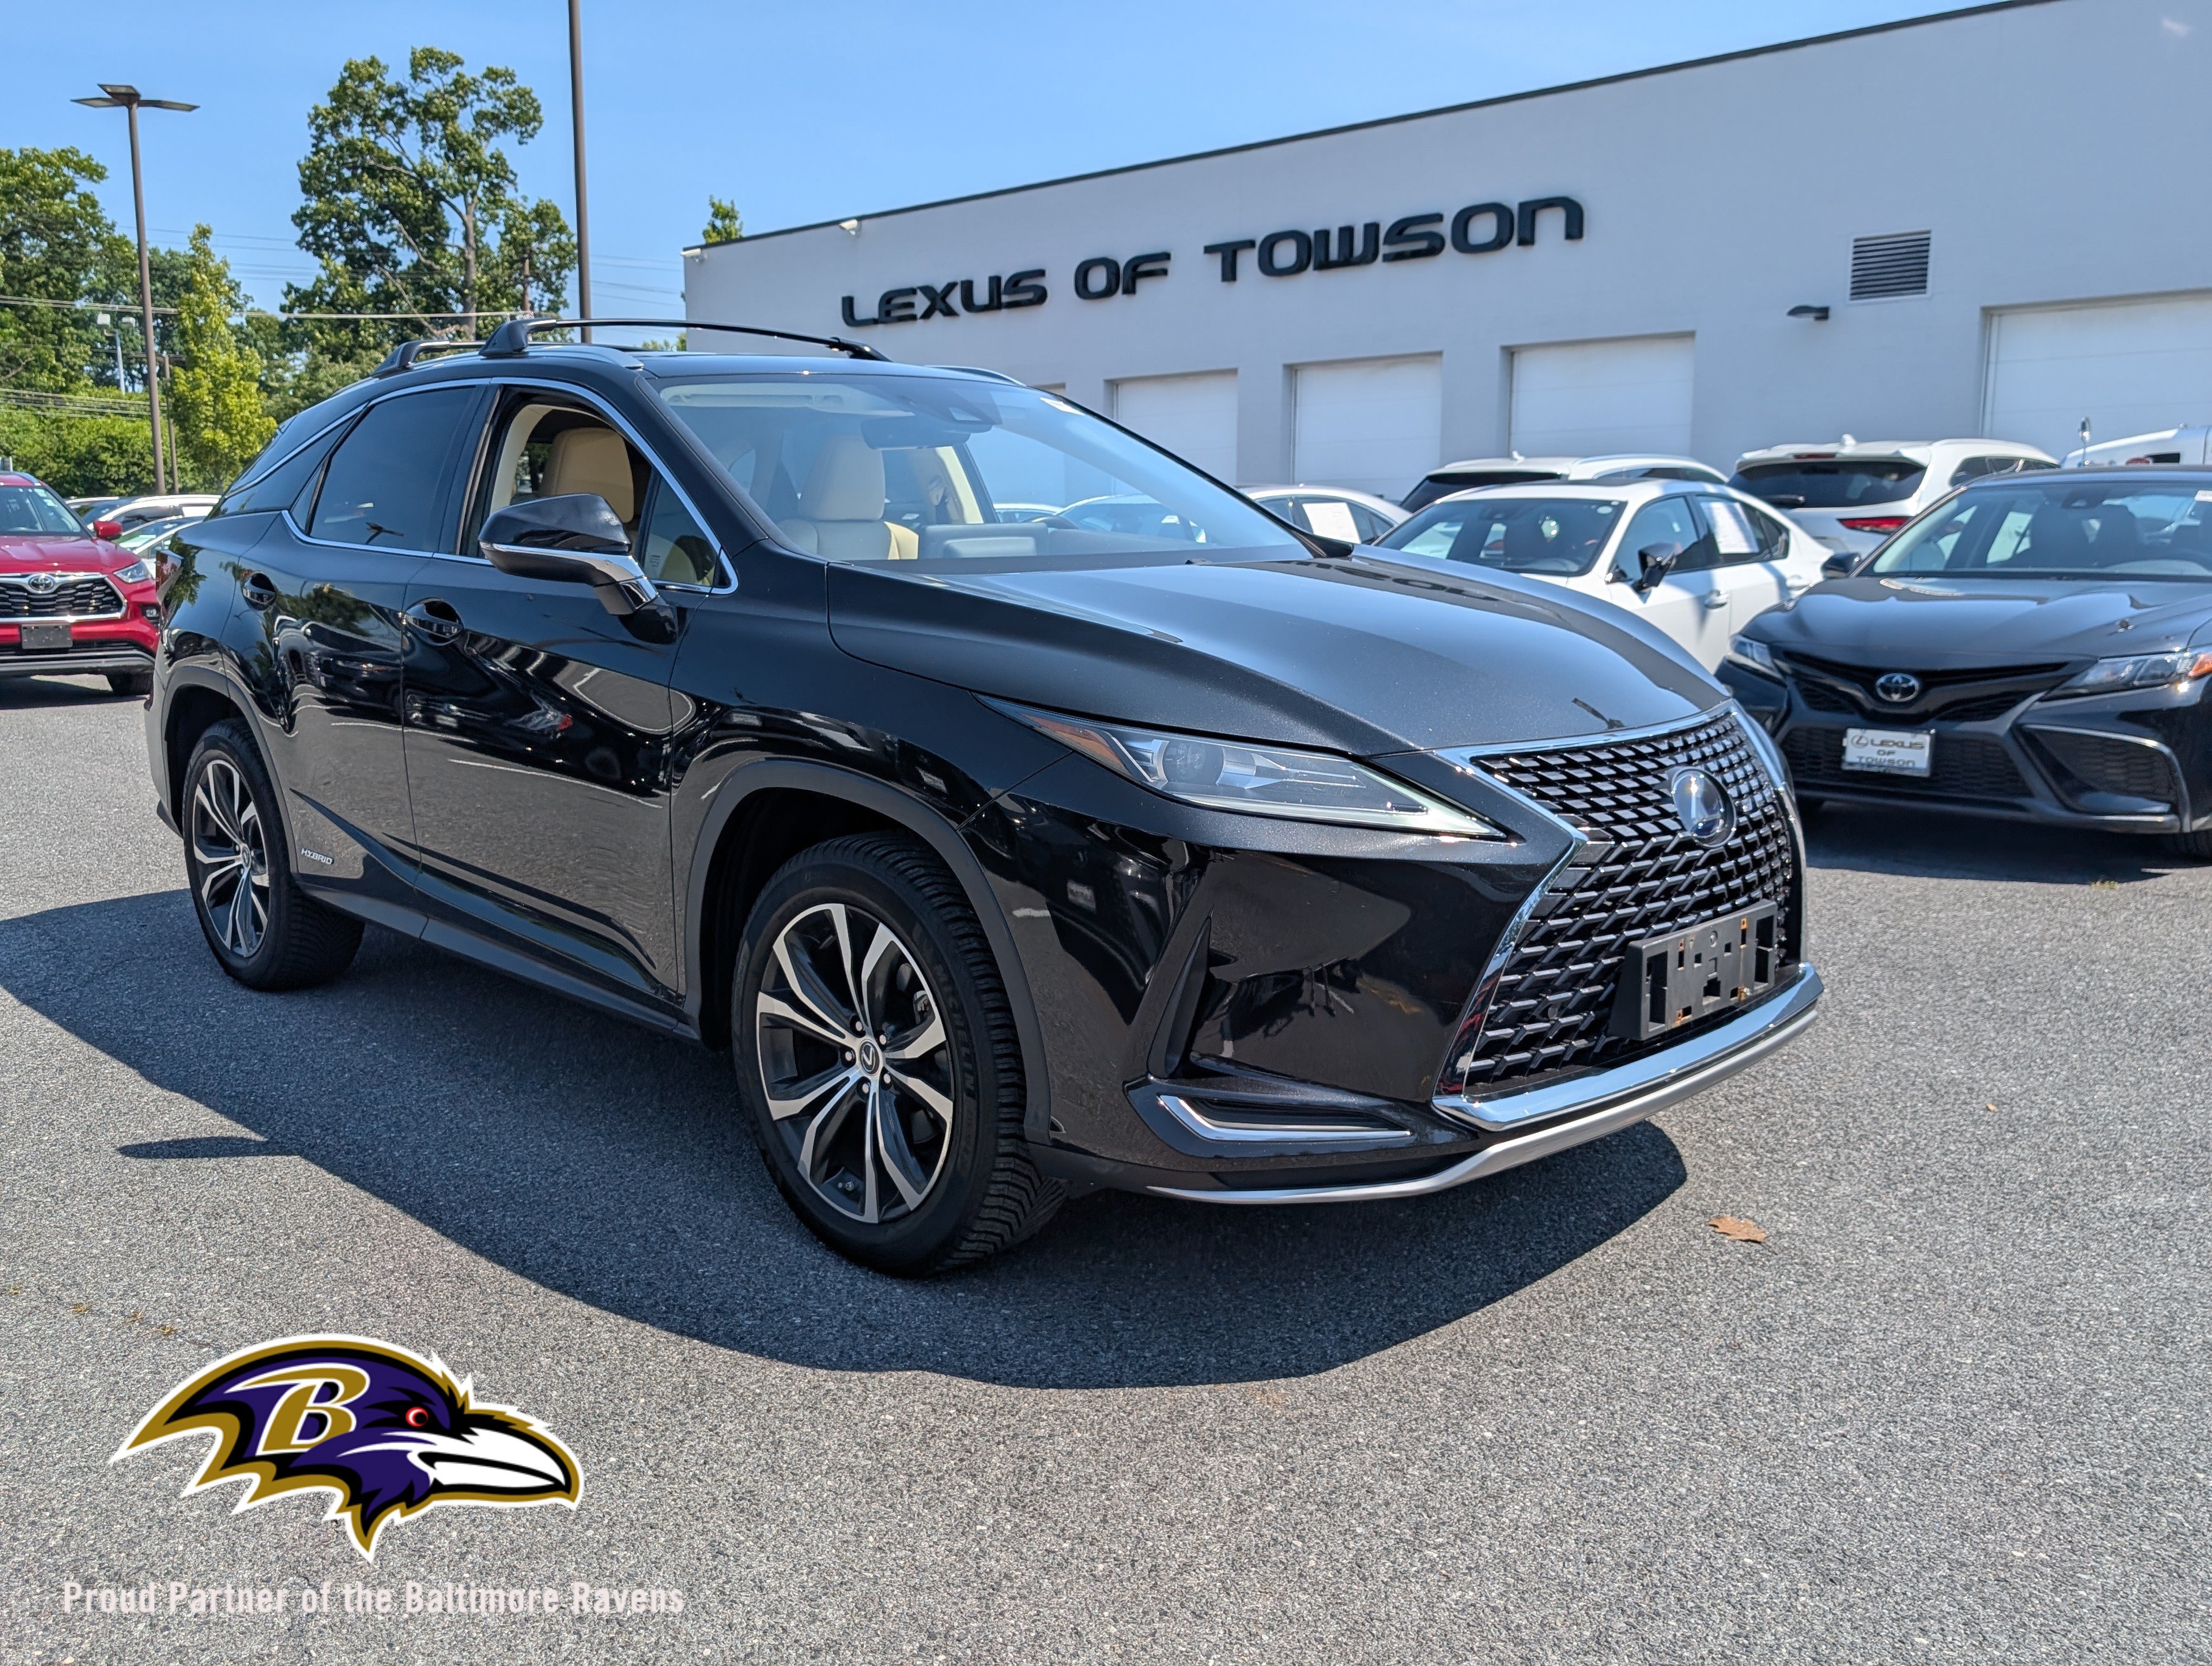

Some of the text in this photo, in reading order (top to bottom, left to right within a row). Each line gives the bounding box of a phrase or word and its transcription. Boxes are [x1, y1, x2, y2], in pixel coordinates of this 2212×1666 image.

[841, 195, 1585, 328] LEXUS OF TOWSON
[1870, 738, 1925, 750] LEXUS
[1856, 755, 1915, 767] TOWSON
[301, 848, 333, 865] HYBRID
